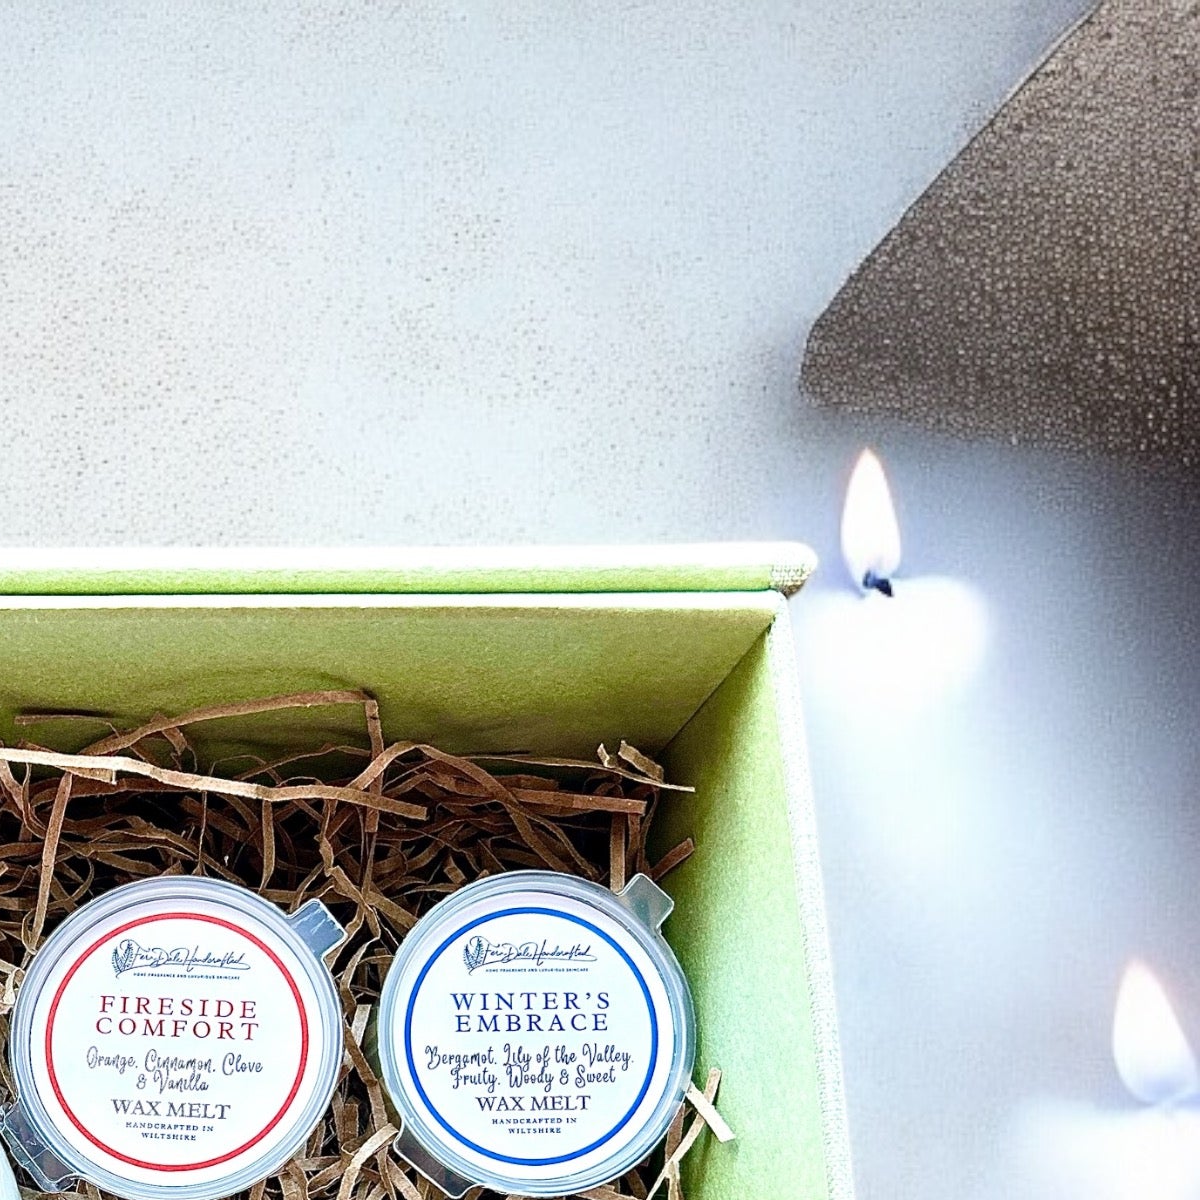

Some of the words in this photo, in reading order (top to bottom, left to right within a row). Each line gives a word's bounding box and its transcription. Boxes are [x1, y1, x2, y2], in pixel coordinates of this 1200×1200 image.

[100, 995, 257, 1019] FIRESIDE
[96, 1017, 259, 1041] COMFORT
[455, 1013, 608, 1033] EMBRACE
[222, 1052, 263, 1076] Clove
[503, 1043, 532, 1072] Lily
[536, 1046, 550, 1068] of
[555, 1045, 577, 1064] the
[136, 1073, 147, 1089] &
[154, 1069, 209, 1094] Vanilla
[506, 1064, 554, 1092] Woody
[559, 1069, 569, 1085] &
[575, 1064, 616, 1088] Sweet
[111, 1099, 162, 1117] WAX
[166, 1101, 231, 1120] MELT
[475, 1096, 526, 1112] WAX
[530, 1095, 591, 1111] MELT
[126, 1122, 198, 1132] HANDCRAFTED
[492, 1117, 563, 1125] HANDCRAFTED
[141, 1132, 197, 1141] WILTSHIRE
